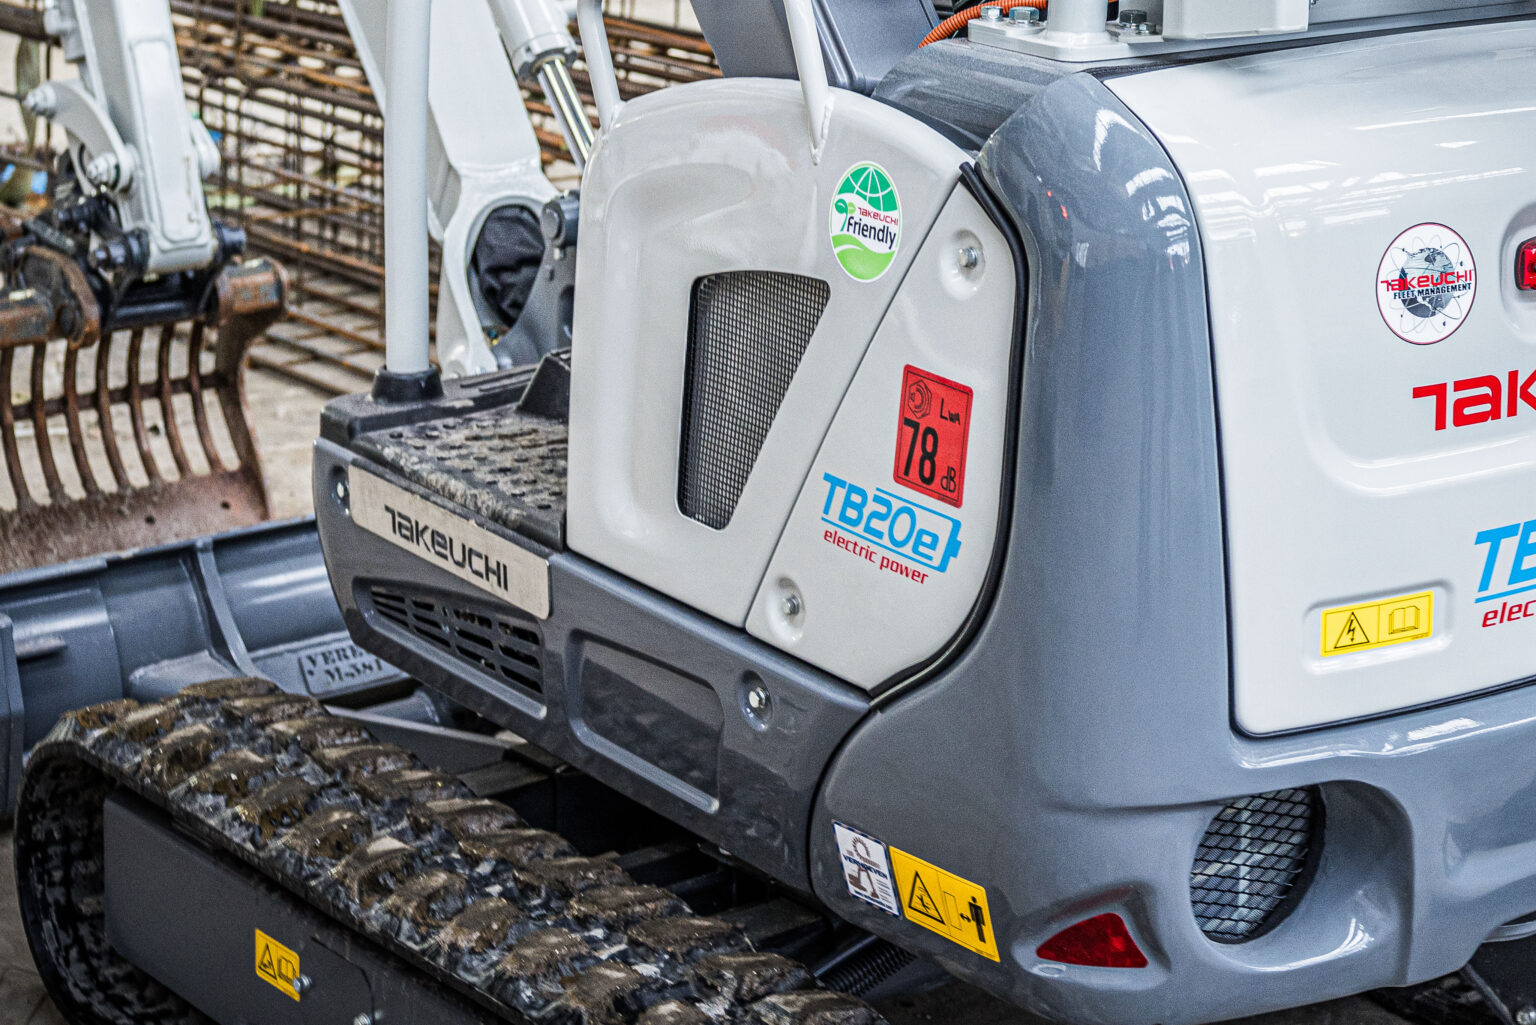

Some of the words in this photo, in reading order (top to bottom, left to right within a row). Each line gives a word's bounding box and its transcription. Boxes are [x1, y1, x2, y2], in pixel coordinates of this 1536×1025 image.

[858, 207, 898, 227] TAKEUCHI
[1381, 269, 1472, 292] TAKEUCHI
[1393, 289, 1415, 300] FLEET
[1416, 282, 1472, 297] MANAGEMENT
[903, 416, 939, 487] 78
[940, 465, 957, 494] dB
[821, 471, 940, 563] TB20e
[384, 504, 509, 592] TAKEUCHI
[823, 530, 877, 563] electric
[880, 553, 929, 584] power
